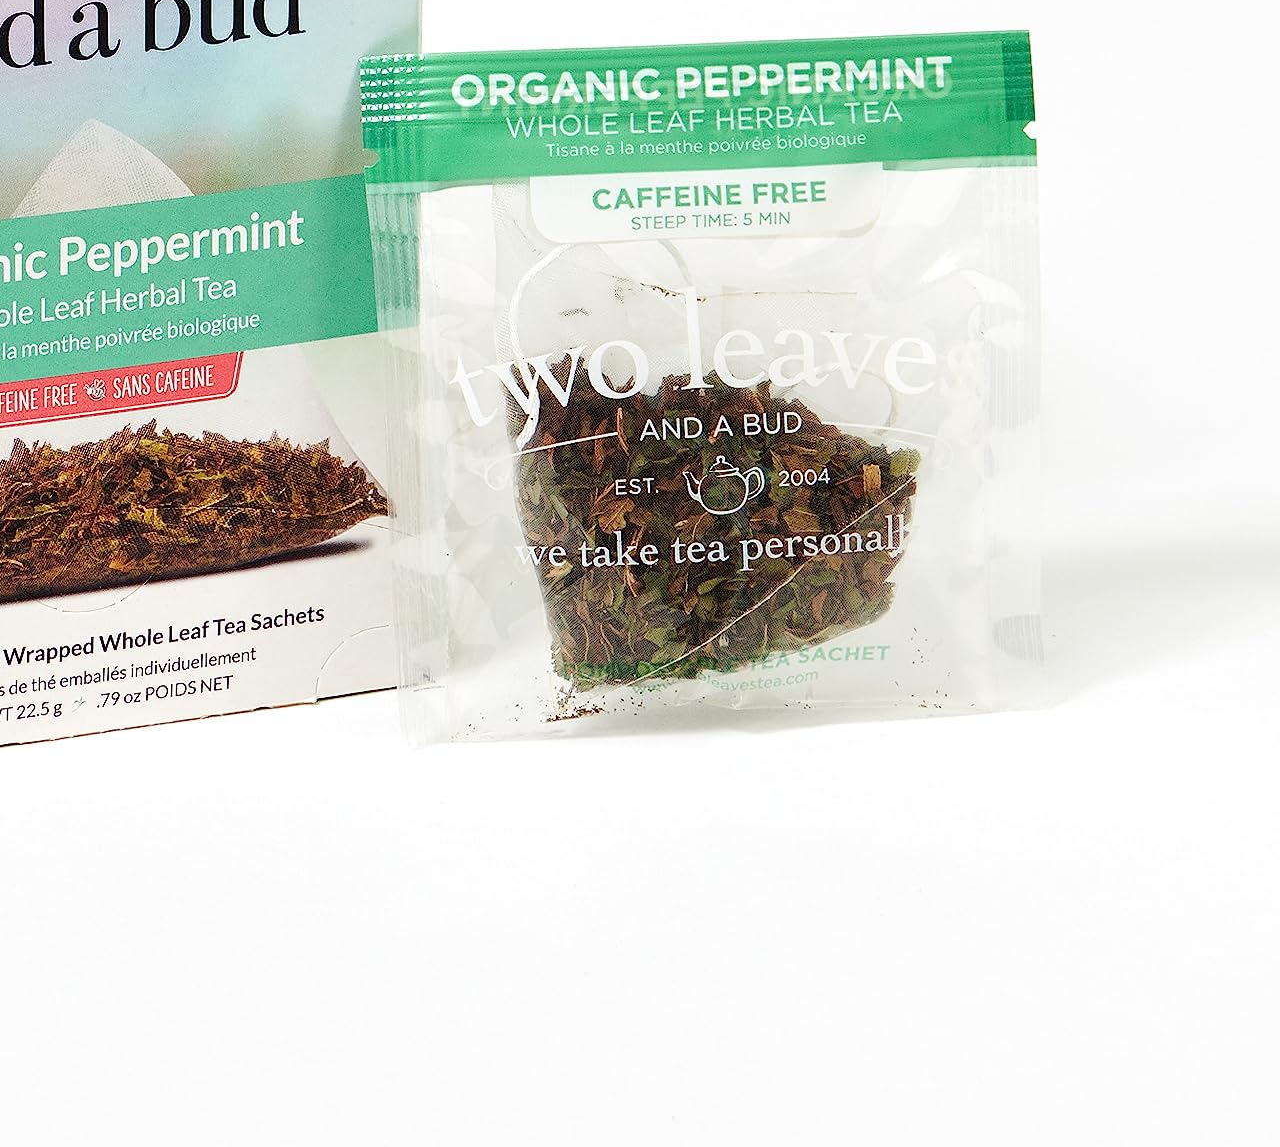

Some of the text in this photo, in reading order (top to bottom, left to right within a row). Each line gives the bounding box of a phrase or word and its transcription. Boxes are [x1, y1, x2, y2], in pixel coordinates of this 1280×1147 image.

[68, 0, 122, 61] a
[451, 68, 661, 107] ORGANIC
[676, 56, 952, 99] PEPPERMINT
[506, 101, 903, 138] WHOLE LEAF HERBAL TEA
[546, 132, 866, 157] Tisane à la menthe poivrée biologique
[591, 180, 828, 211] CAFFEINE FREE
[59, 209, 306, 277] Peppermint
[631, 211, 791, 231] STEEP TIME: 5 MIN
[39, 291, 96, 324] Leaf
[101, 280, 187, 315] Herbal
[191, 276, 238, 302] Tea
[1, 342, 18, 360] la
[21, 333, 91, 359] menthe
[95, 324, 163, 353] poivrée
[167, 312, 261, 340] biologique
[448, 285, 938, 427] two leave
[43, 383, 78, 408] FREE
[113, 373, 151, 399] SANS
[154, 365, 214, 393] CAFEINE
[639, 412, 803, 442] AND A BUD
[614, 470, 831, 496] EST. 2004
[514, 541, 568, 568] we
[577, 531, 659, 569] take
[671, 538, 730, 564] tea
[3, 636, 95, 665] Wrapped
[99, 629, 164, 653] Whole
[168, 620, 209, 643] Leaf
[213, 618, 246, 637] Tea
[250, 606, 325, 631] Sachets
[8, 679, 28, 696] de
[32, 675, 56, 692] thé
[59, 666, 127, 688] emballés
[130, 647, 257, 678] individuellement
[752, 651, 790, 671] TEA
[798, 645, 890, 663] SACHET
[16, 701, 50, 720] 22.5
[53, 702, 63, 717] g
[96, 691, 120, 709] .79
[123, 692, 141, 704] oz
[145, 681, 197, 701] POIDS
[200, 675, 234, 693] NET
